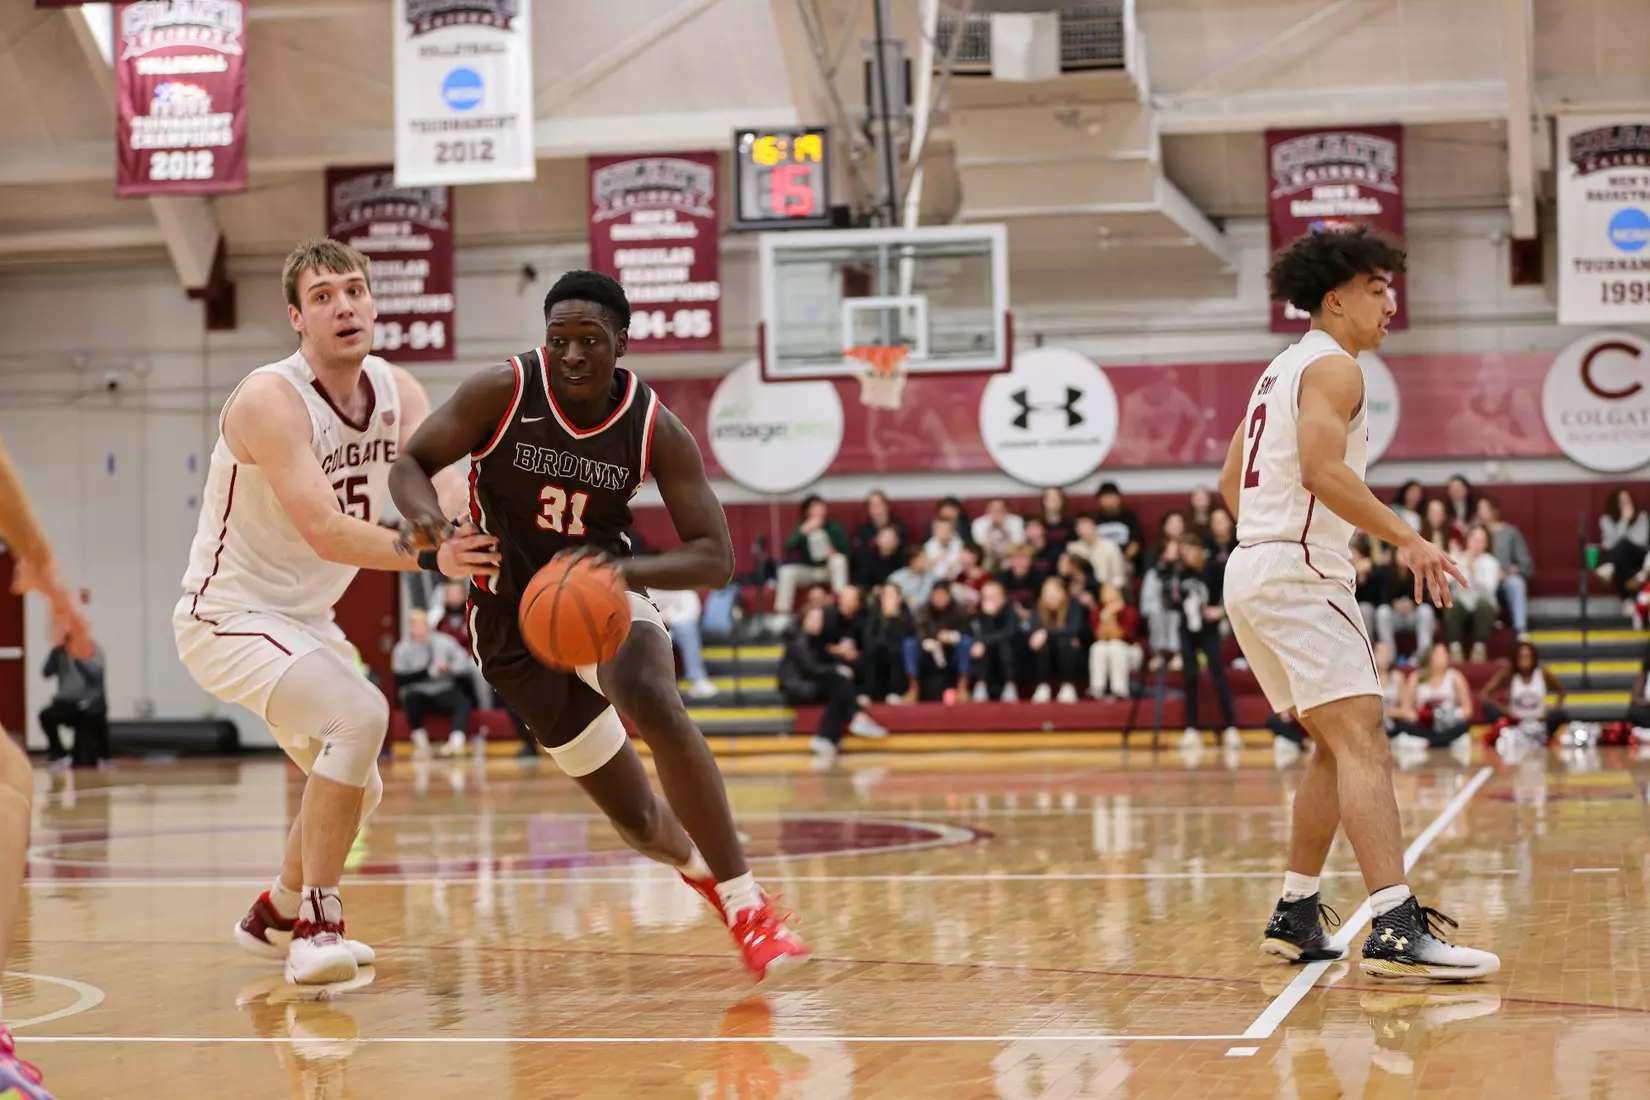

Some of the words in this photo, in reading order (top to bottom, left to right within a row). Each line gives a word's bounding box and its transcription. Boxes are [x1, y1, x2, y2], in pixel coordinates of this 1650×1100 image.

[149, 150, 214, 180] 2012
[433, 139, 495, 164] 2012
[771, 164, 815, 217] 15
[1602, 281, 1650, 305] 199
[1580, 341, 1642, 399] C
[321, 438, 397, 475] COLGATE
[513, 442, 630, 491] BROWN
[1244, 403, 1267, 489] 2
[535, 483, 590, 537] 31
